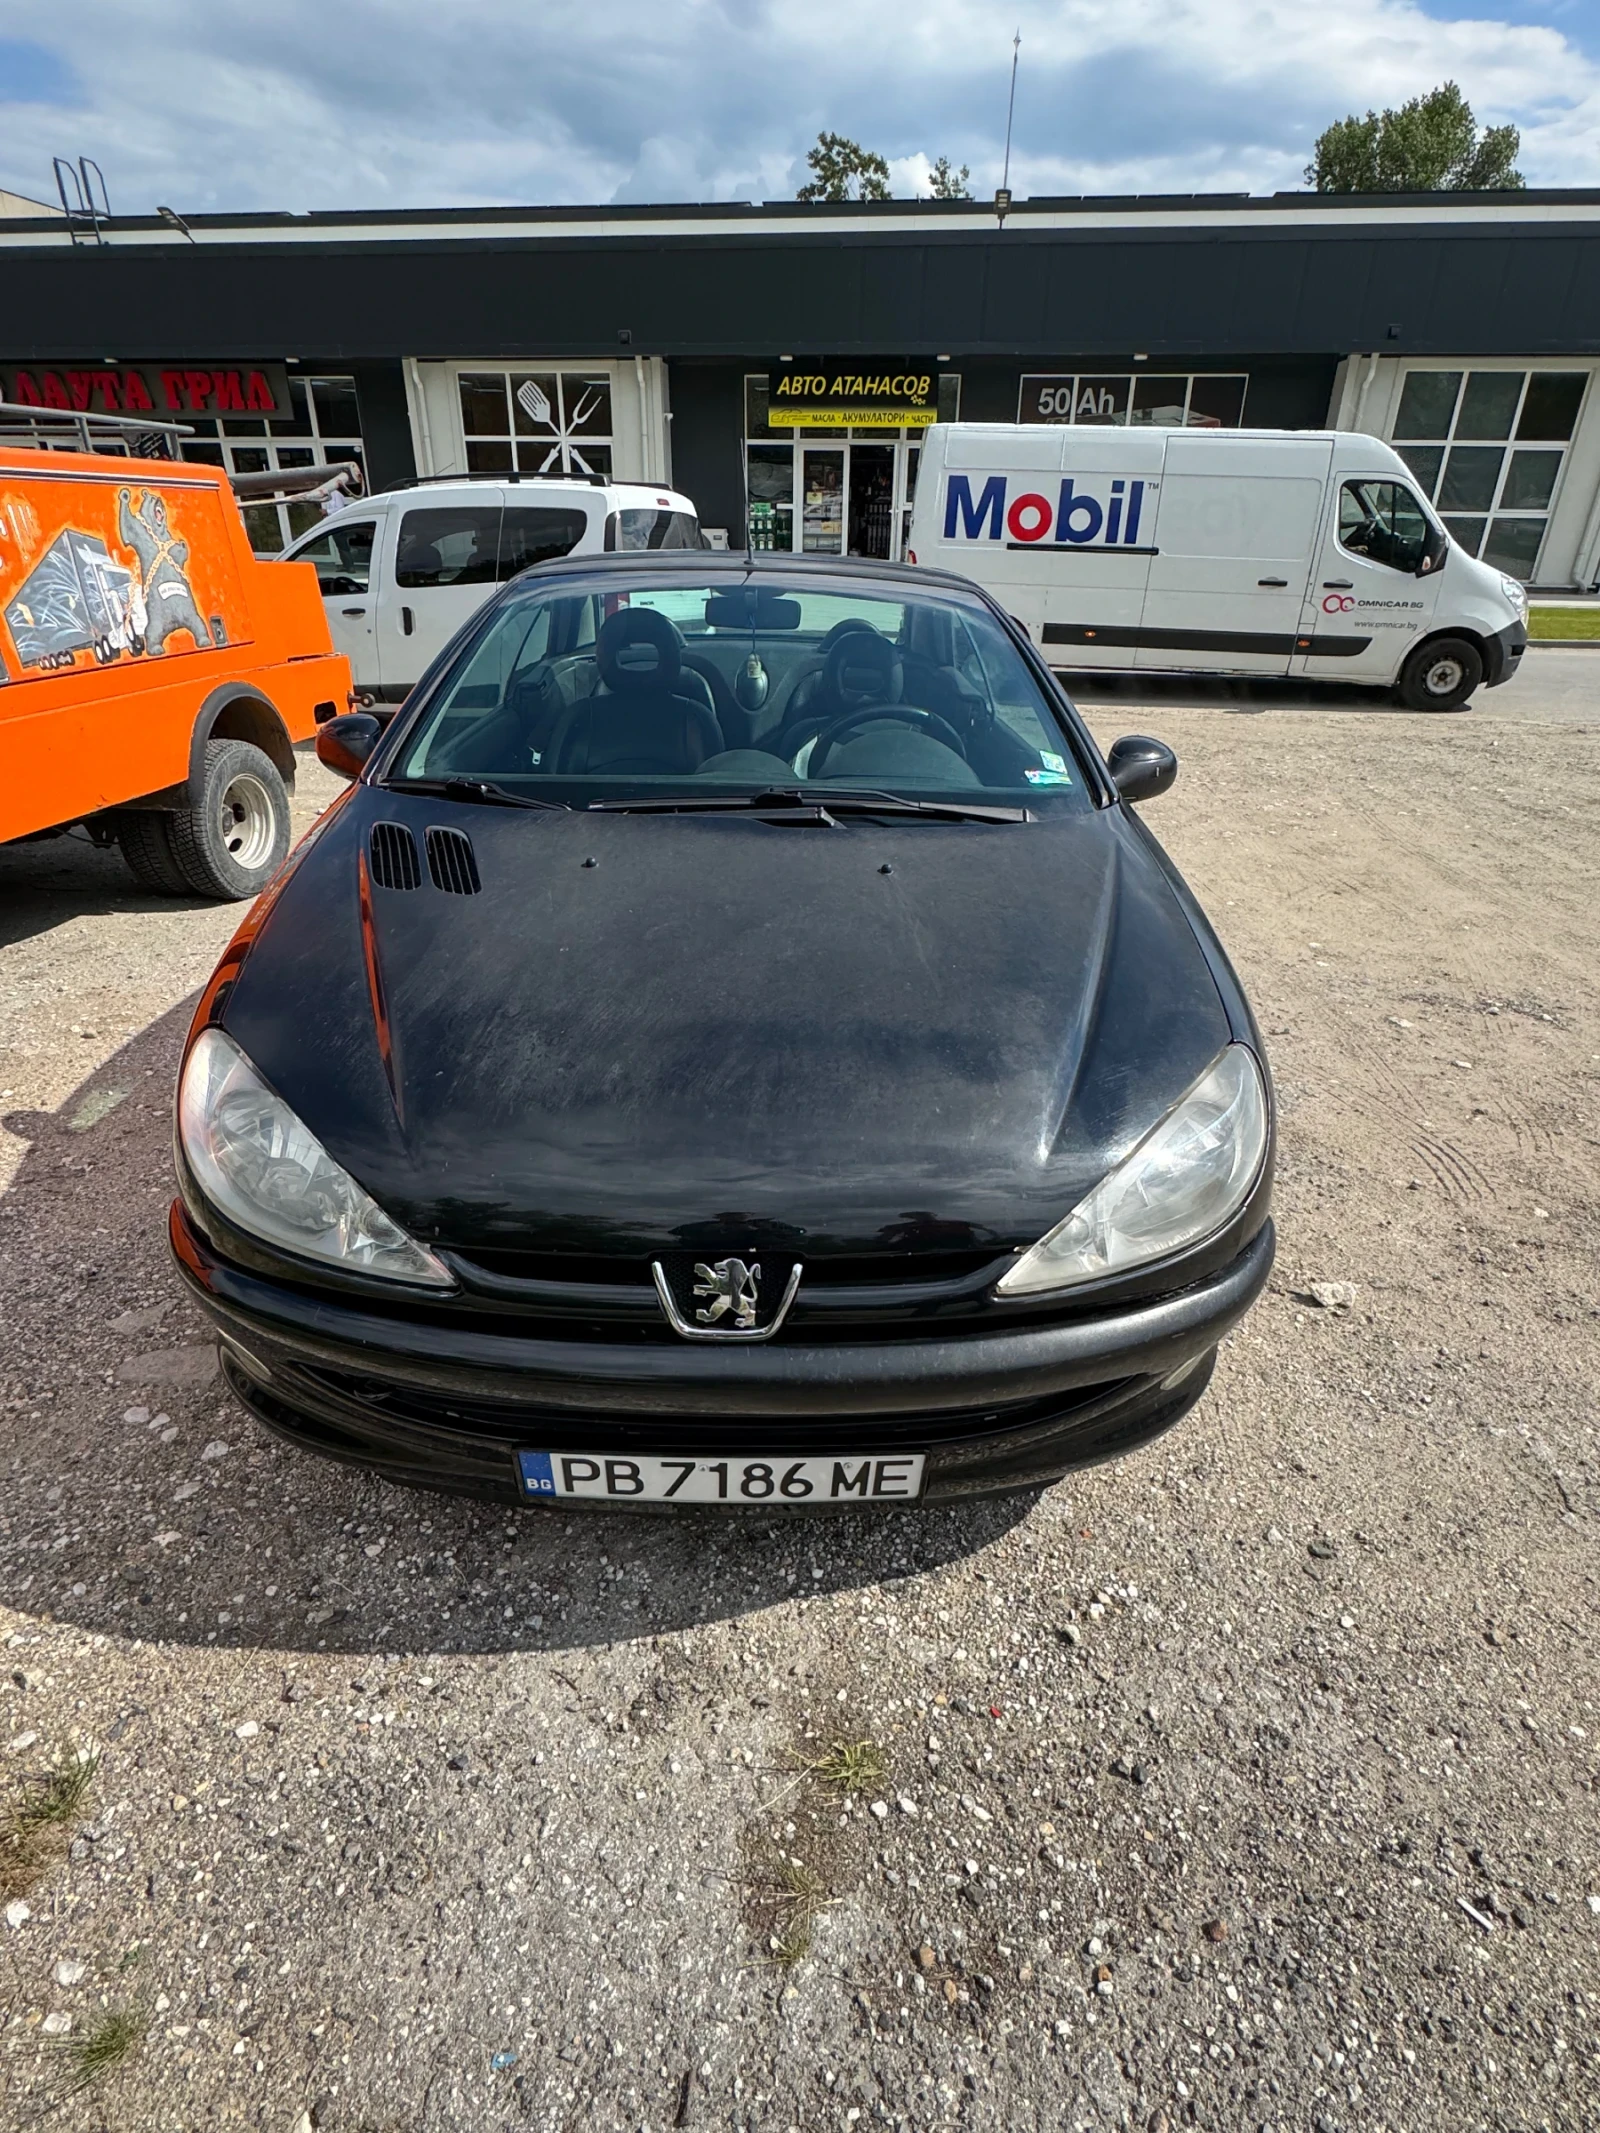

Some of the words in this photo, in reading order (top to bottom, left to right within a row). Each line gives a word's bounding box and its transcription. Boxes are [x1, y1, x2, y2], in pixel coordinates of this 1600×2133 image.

[15, 371, 154, 411] ЛАУТА
[160, 371, 276, 410] ГРИЛ
[776, 376, 827, 395] АВТО
[829, 376, 931, 395] АТАНАСОВ
[1037, 387, 1071, 415] 50
[1077, 387, 1115, 415] Ah
[811, 414, 836, 422] МАСЛА
[841, 412, 905, 423] АКУМУЛАТОРИ
[911, 414, 934, 424] ЧАСТИ
[943, 475, 1145, 544] Mobil
[1357, 600, 1409, 608] OMNICAR
[526, 1478, 552, 1490] BG
[560, 1457, 644, 1495] PB
[660, 1461, 814, 1498] 7186
[830, 1460, 914, 1497] ME
